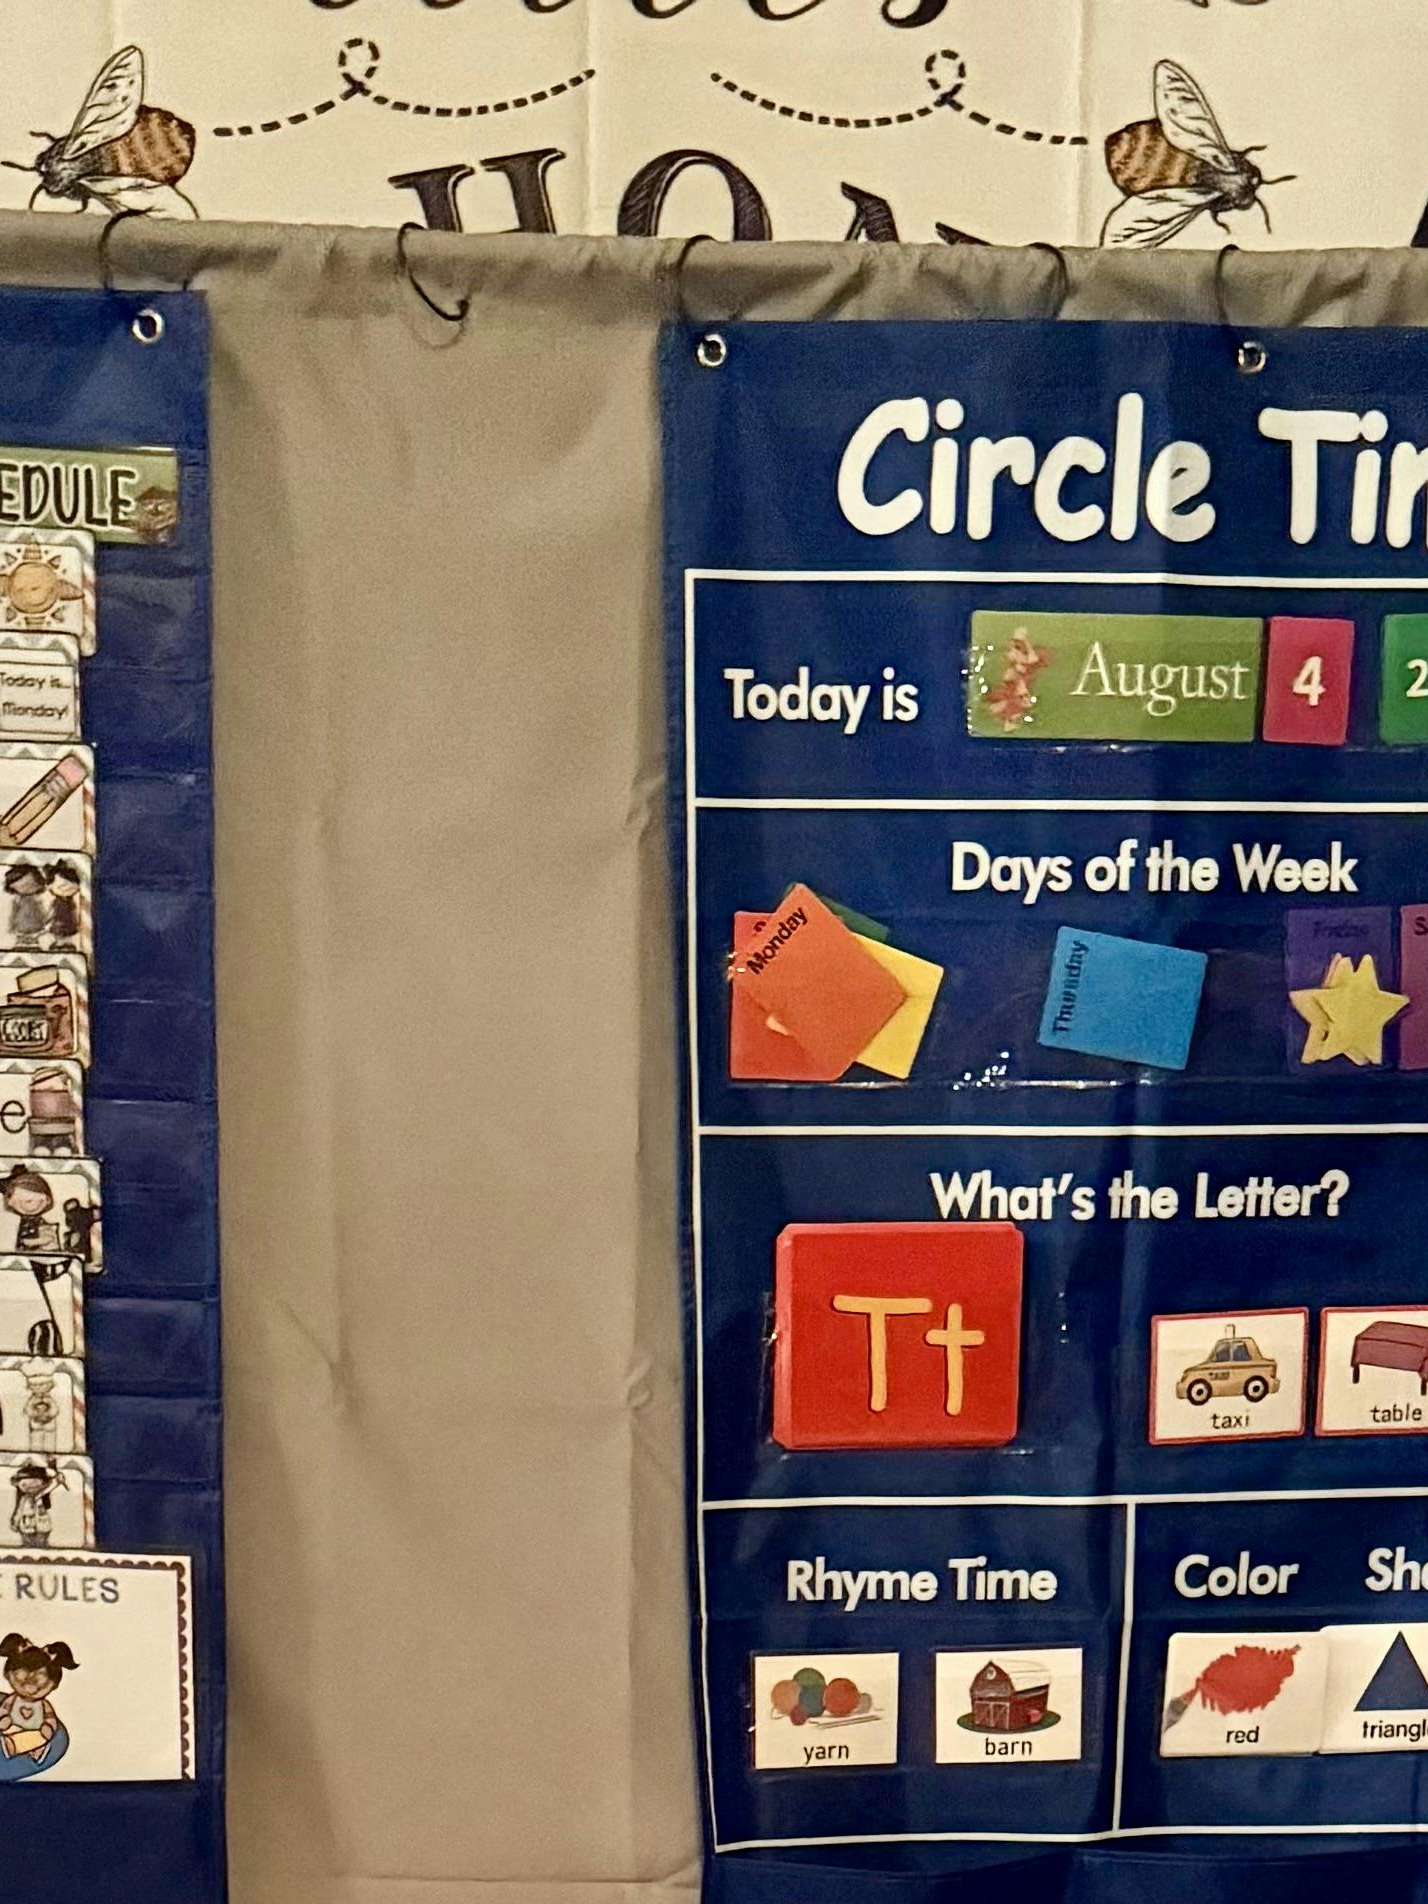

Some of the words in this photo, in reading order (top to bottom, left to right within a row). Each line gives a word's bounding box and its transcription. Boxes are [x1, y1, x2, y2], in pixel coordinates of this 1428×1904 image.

[837, 393, 1217, 543] Circle
[0, 672, 46, 690] Today
[724, 668, 872, 735] Today
[883, 667, 919, 723] is
[1071, 642, 1251, 716] August
[1291, 656, 1326, 708] 4
[951, 842, 1072, 905] Days
[1085, 839, 1137, 893] of
[1145, 841, 1220, 893] the
[1232, 843, 1359, 894] Week
[745, 905, 810, 977] Monday
[931, 1172, 1096, 1222] What's
[1108, 1174, 1178, 1220] the
[1194, 1169, 1350, 1220] Letter?
[832, 1294, 985, 1416] Tt
[1211, 1410, 1251, 1431] taxi
[1370, 1402, 1423, 1424] table
[15, 1573, 121, 1605] RULES
[786, 1559, 939, 1612] Rhyme
[949, 1557, 1058, 1602] Time
[1174, 1552, 1299, 1599] Color
[801, 1741, 852, 1766] yarn
[983, 1734, 1035, 1759] barn
[1224, 1724, 1260, 1746] red
